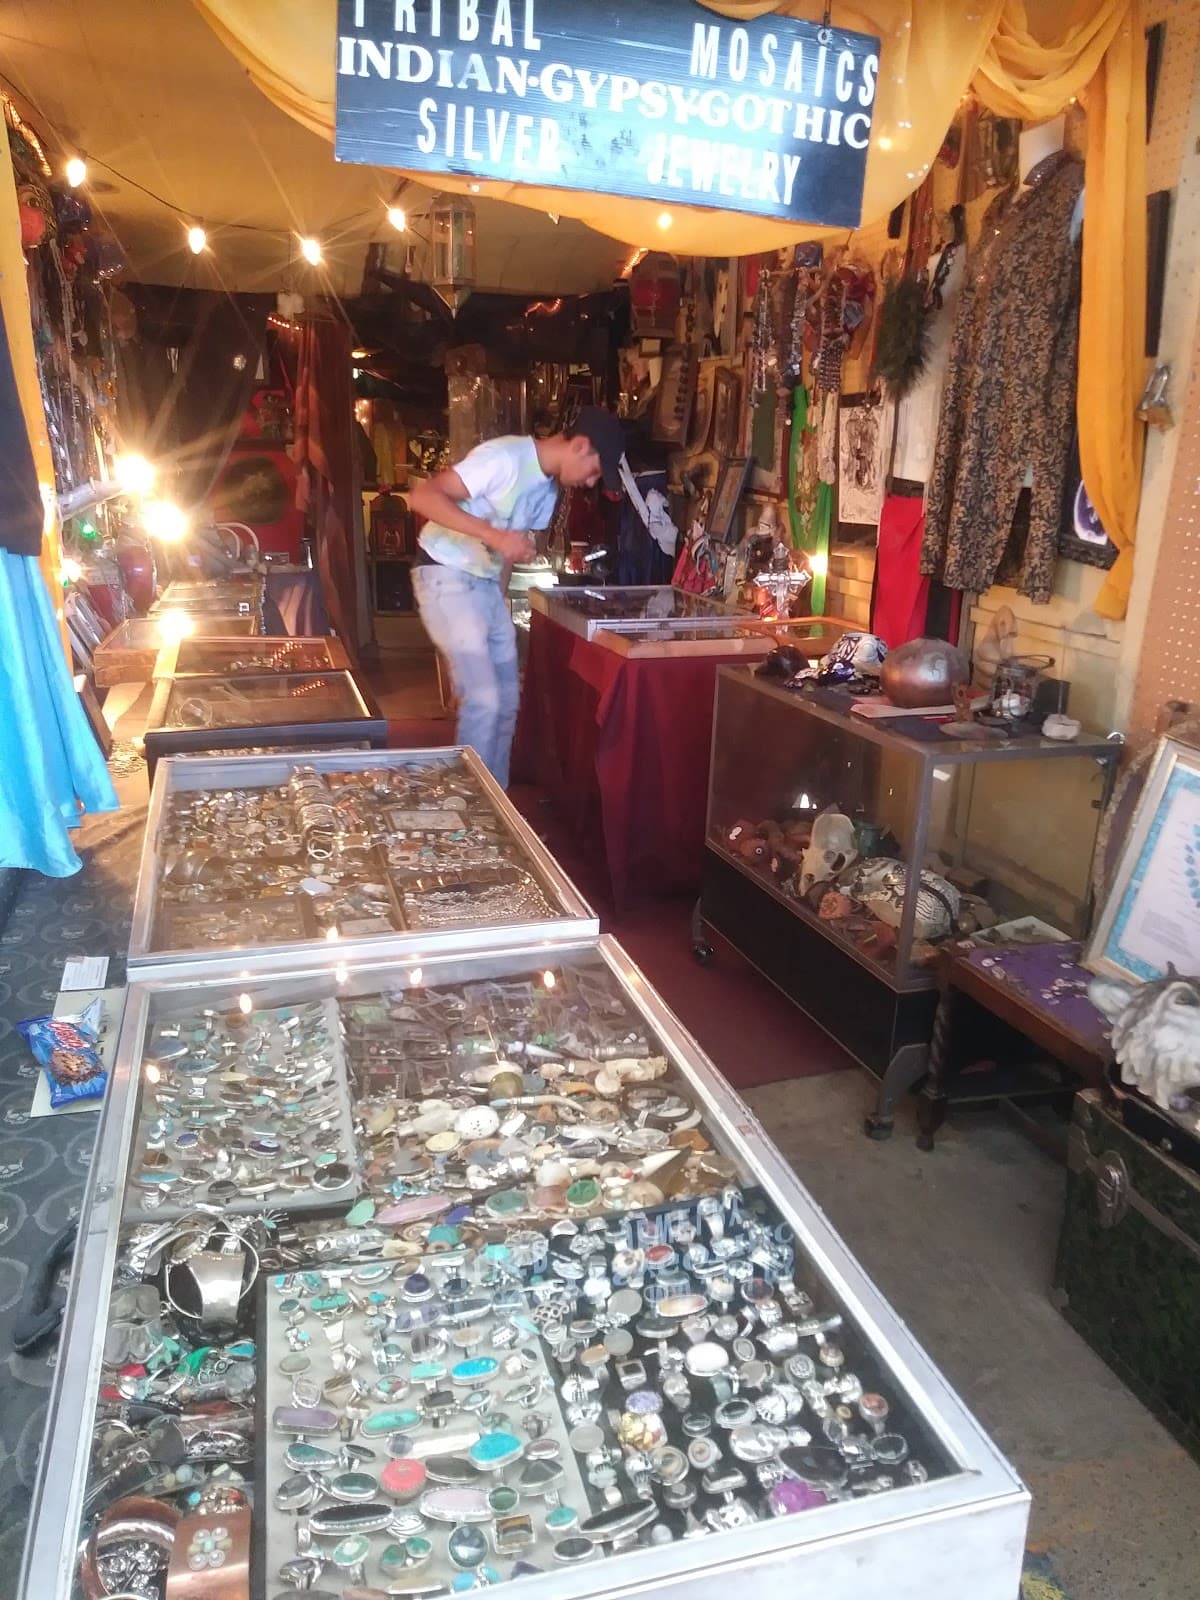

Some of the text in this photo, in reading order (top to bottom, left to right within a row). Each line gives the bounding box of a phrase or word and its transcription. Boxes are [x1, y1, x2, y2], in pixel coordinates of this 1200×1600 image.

[690, 22, 879, 107] MOSAICS
[417, 97, 801, 206] SILVER JEWELRY
